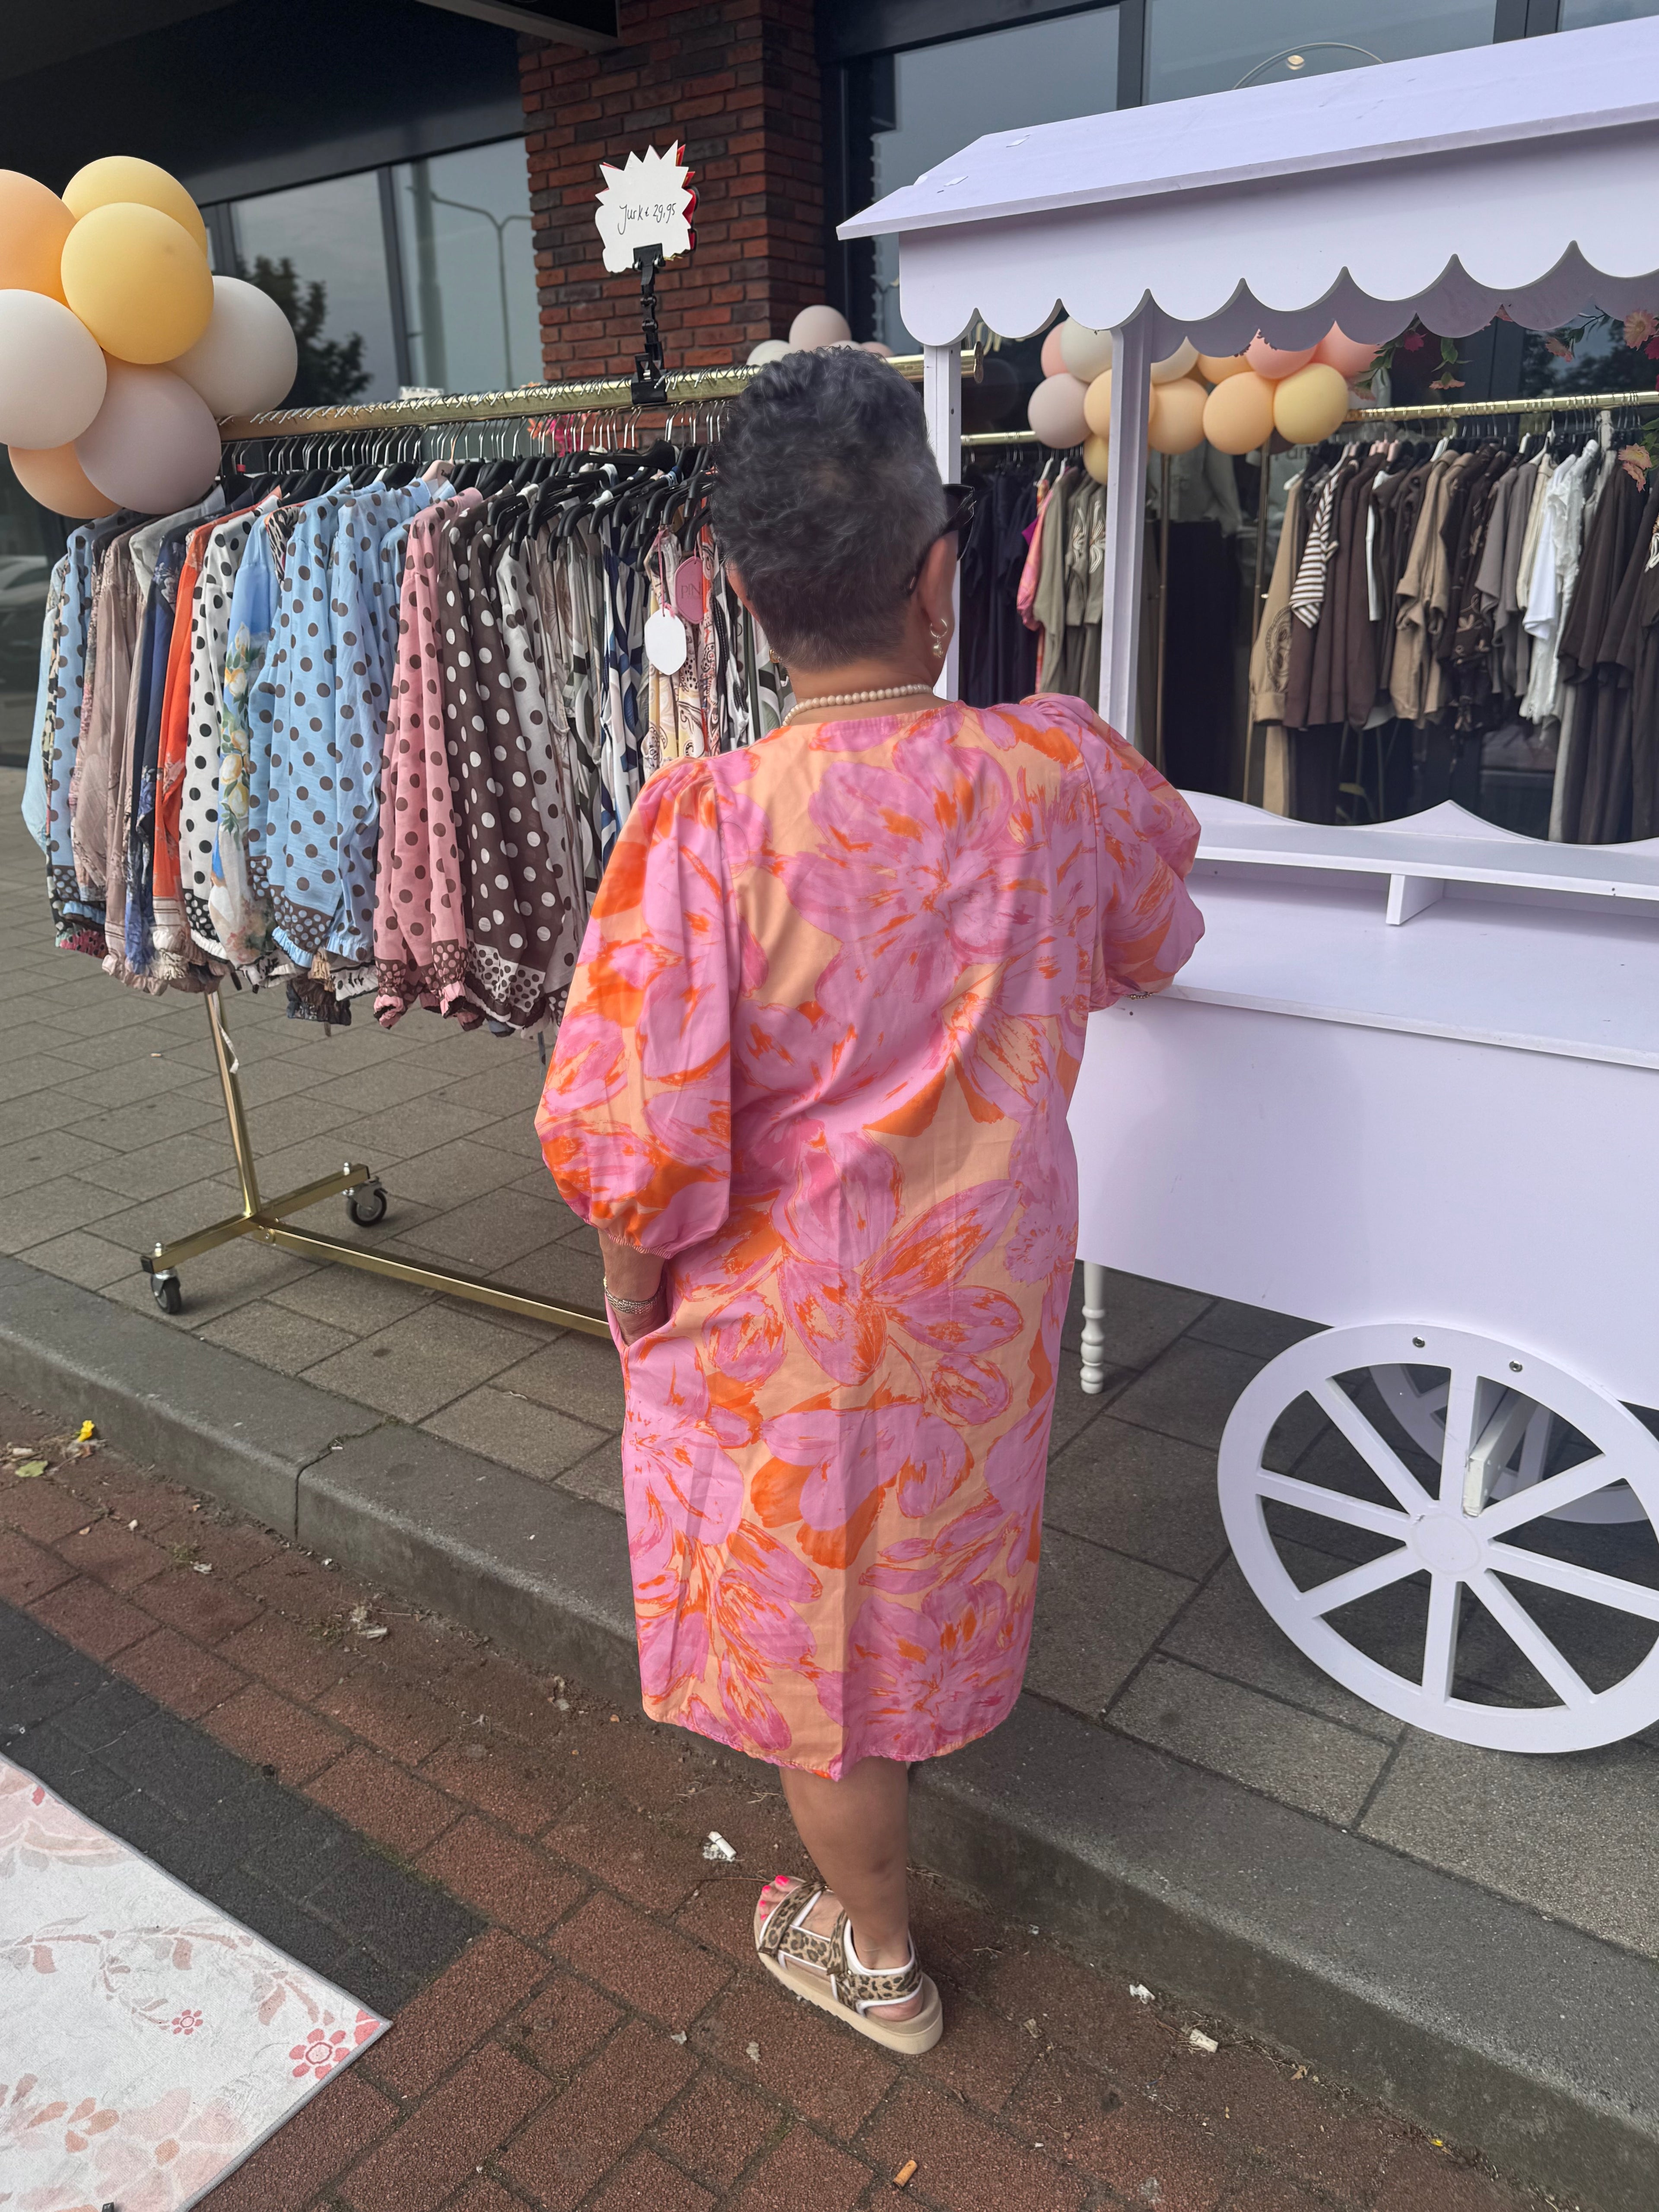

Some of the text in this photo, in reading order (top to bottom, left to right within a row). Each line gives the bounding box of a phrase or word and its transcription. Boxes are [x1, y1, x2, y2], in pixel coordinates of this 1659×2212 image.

[617, 204, 643, 235] Jurk
[652, 203, 677, 224] 29,95
[681, 581, 703, 599] PIN
